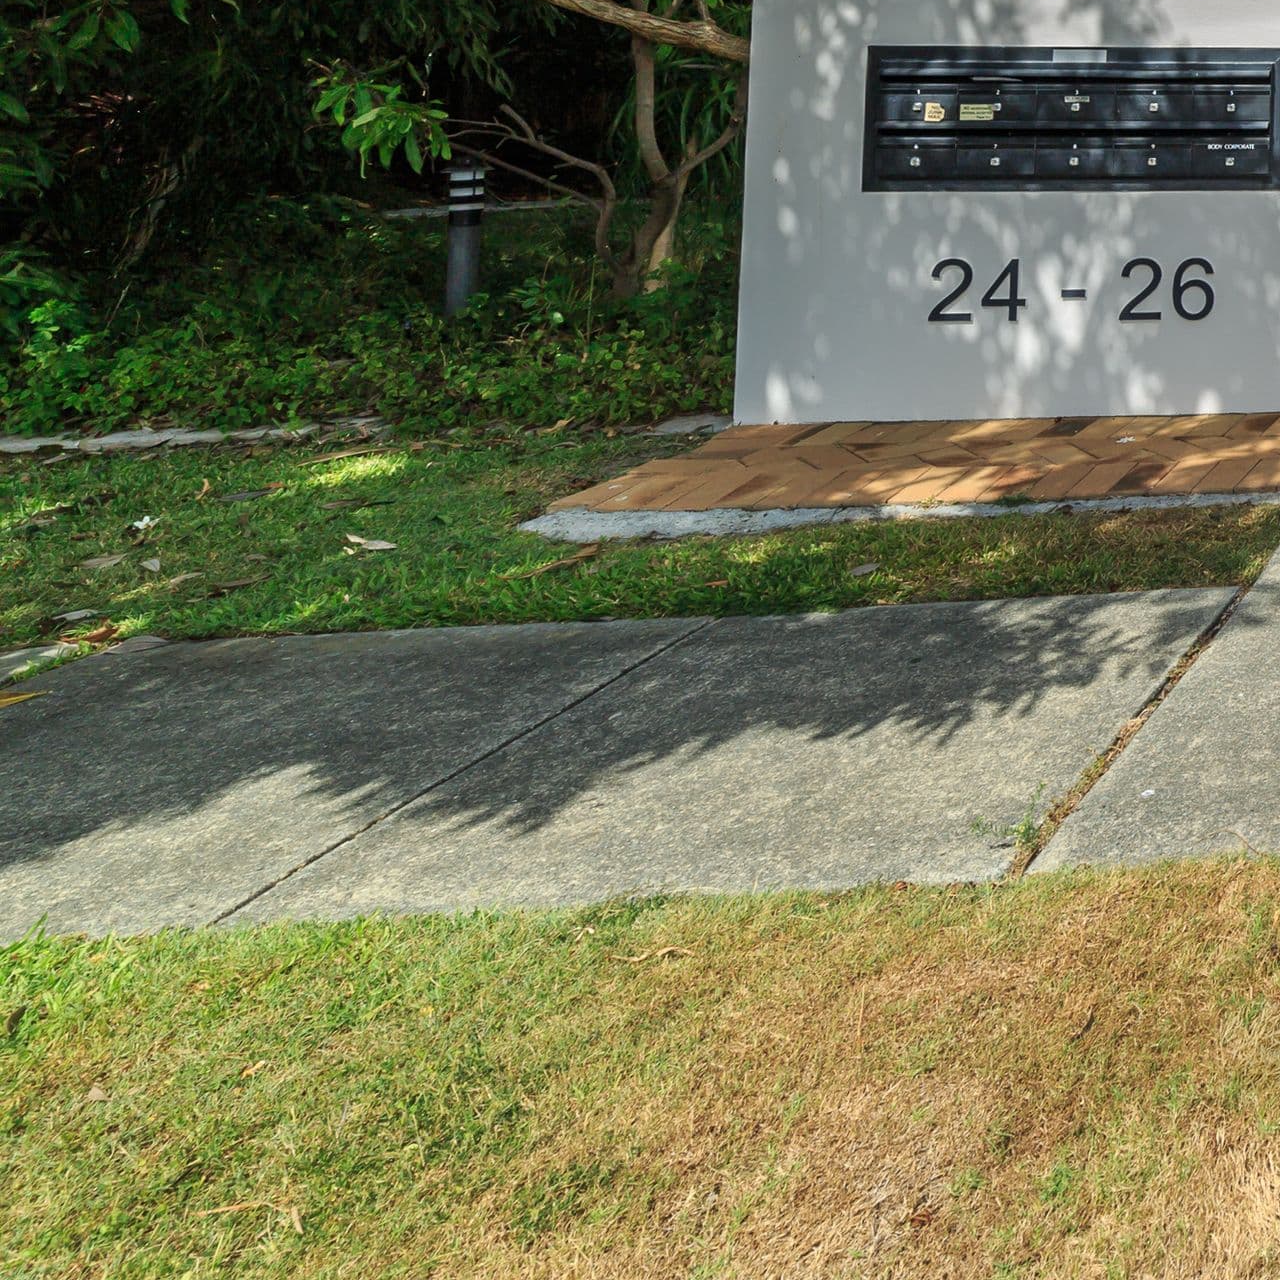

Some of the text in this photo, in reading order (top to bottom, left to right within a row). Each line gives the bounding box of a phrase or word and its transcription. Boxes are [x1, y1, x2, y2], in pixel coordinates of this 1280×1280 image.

[927, 257, 1216, 322] 24 - 26
